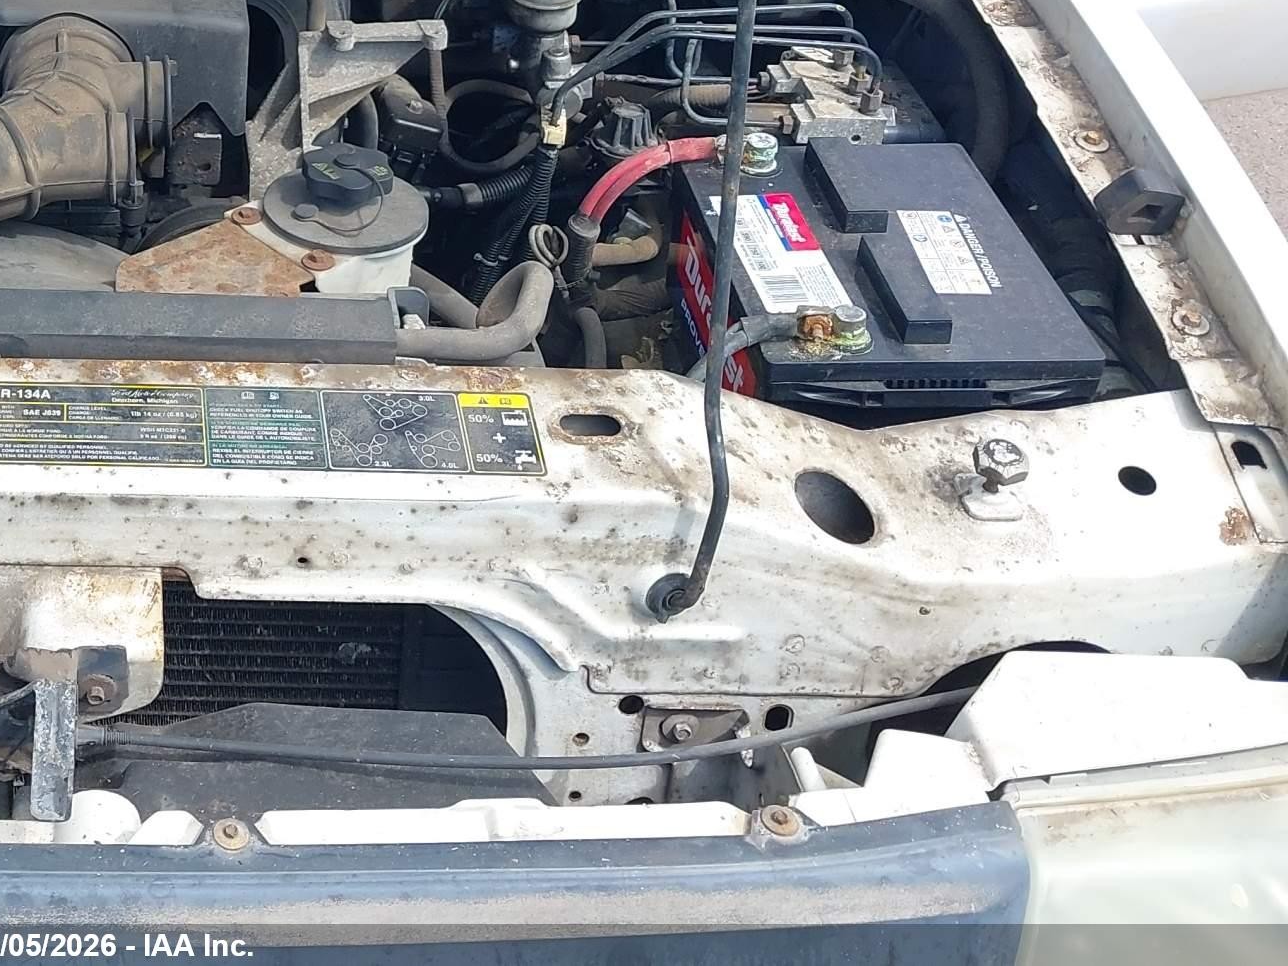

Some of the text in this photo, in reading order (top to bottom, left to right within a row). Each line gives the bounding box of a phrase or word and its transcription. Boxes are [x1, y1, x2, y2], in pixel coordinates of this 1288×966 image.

[0, 388, 52, 399] R-134A
[468, 414, 494, 424] 50%
[476, 453, 503, 464] 50%
